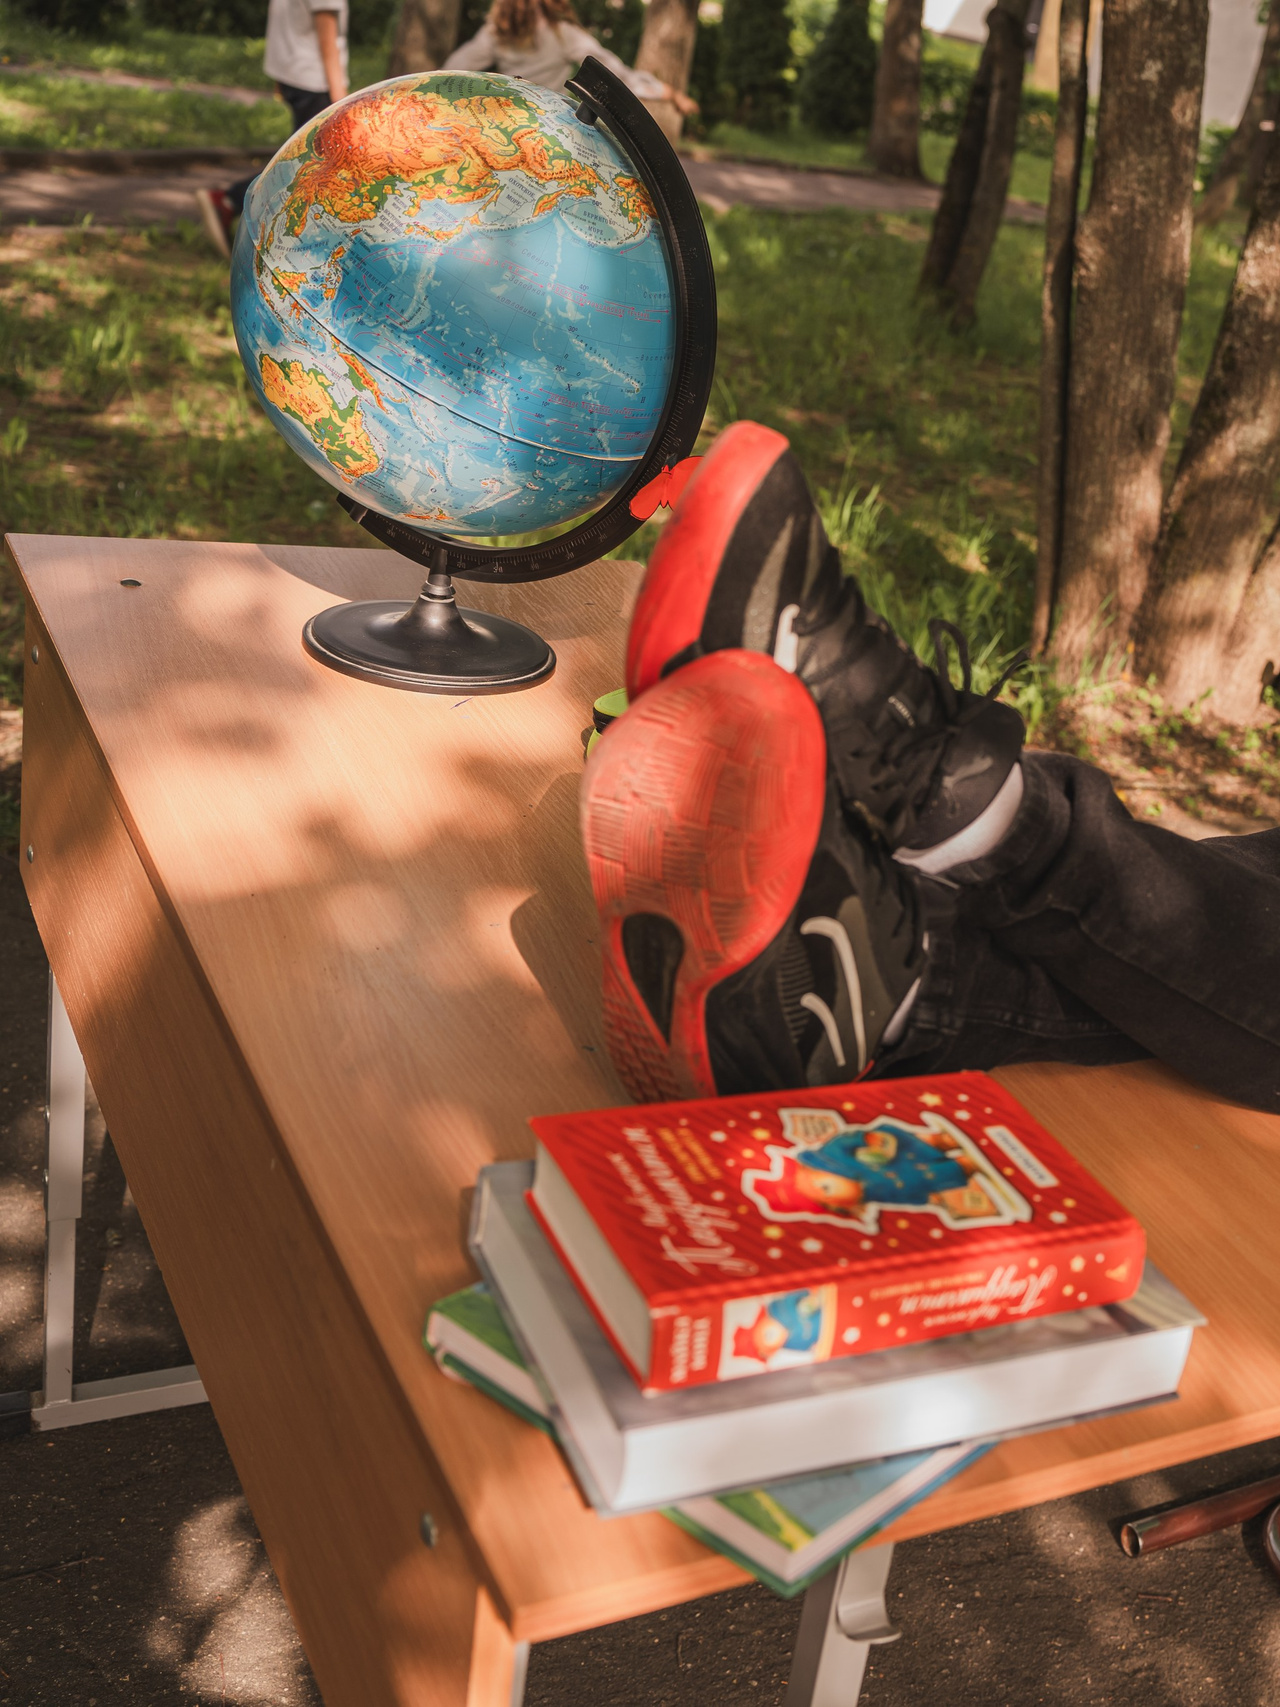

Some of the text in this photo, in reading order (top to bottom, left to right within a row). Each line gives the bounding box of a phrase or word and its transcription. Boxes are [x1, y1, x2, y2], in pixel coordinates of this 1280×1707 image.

[508, 177, 536, 198] ОХОТСКОЕ
[506, 194, 521, 207] МОРЕ
[583, 210, 616, 226] БЕРИНГОВО
[587, 225, 604, 236] МОРЕ
[495, 295, 537, 317] котловина
